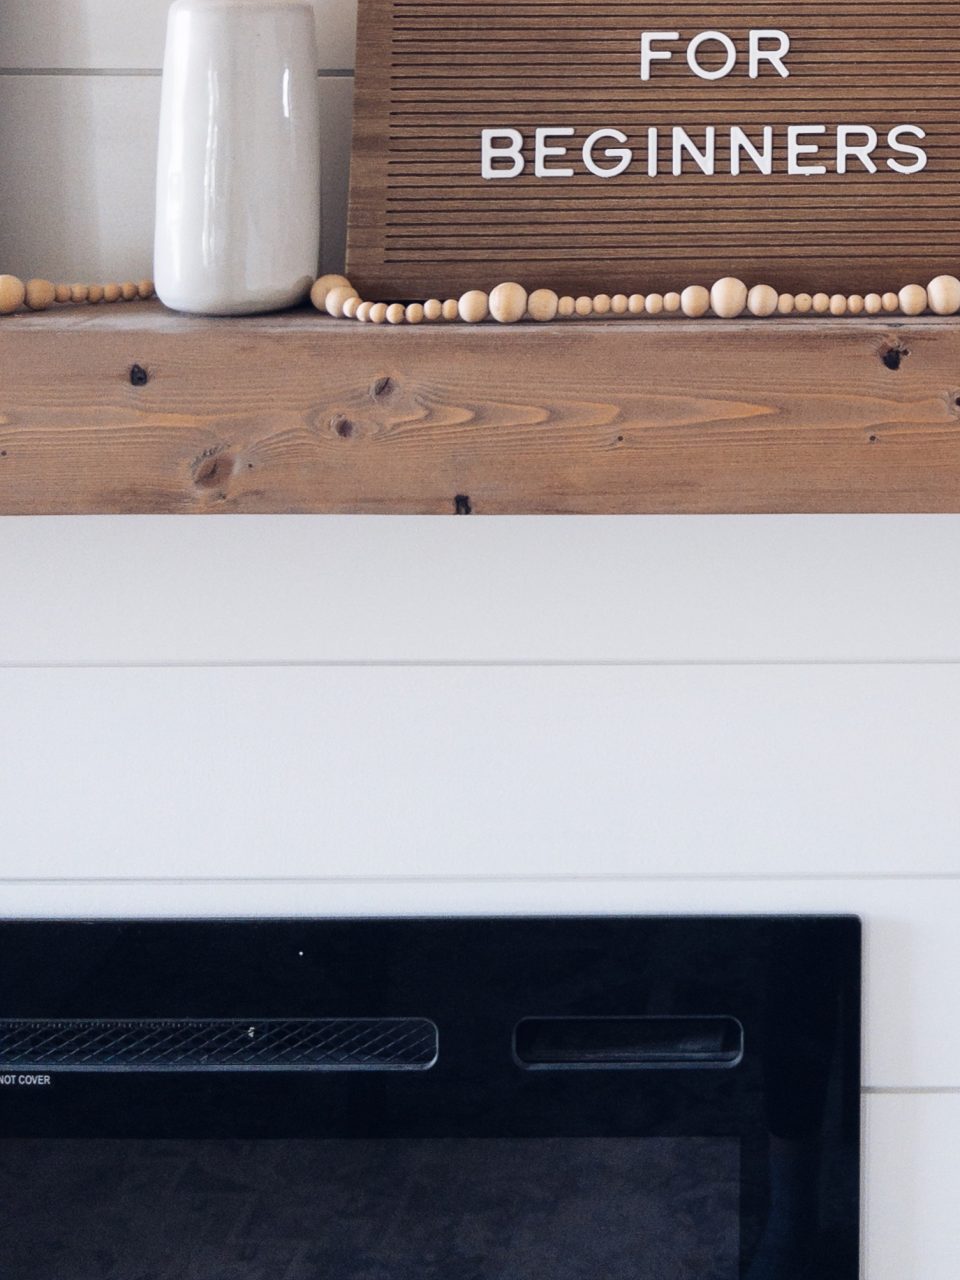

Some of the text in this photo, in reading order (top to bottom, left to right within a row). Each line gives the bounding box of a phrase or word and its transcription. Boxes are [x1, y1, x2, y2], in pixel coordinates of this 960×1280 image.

[639, 28, 791, 81] FOR
[480, 123, 929, 179] BEGINNERS
[0, 1075, 51, 1085] NOT COVER
